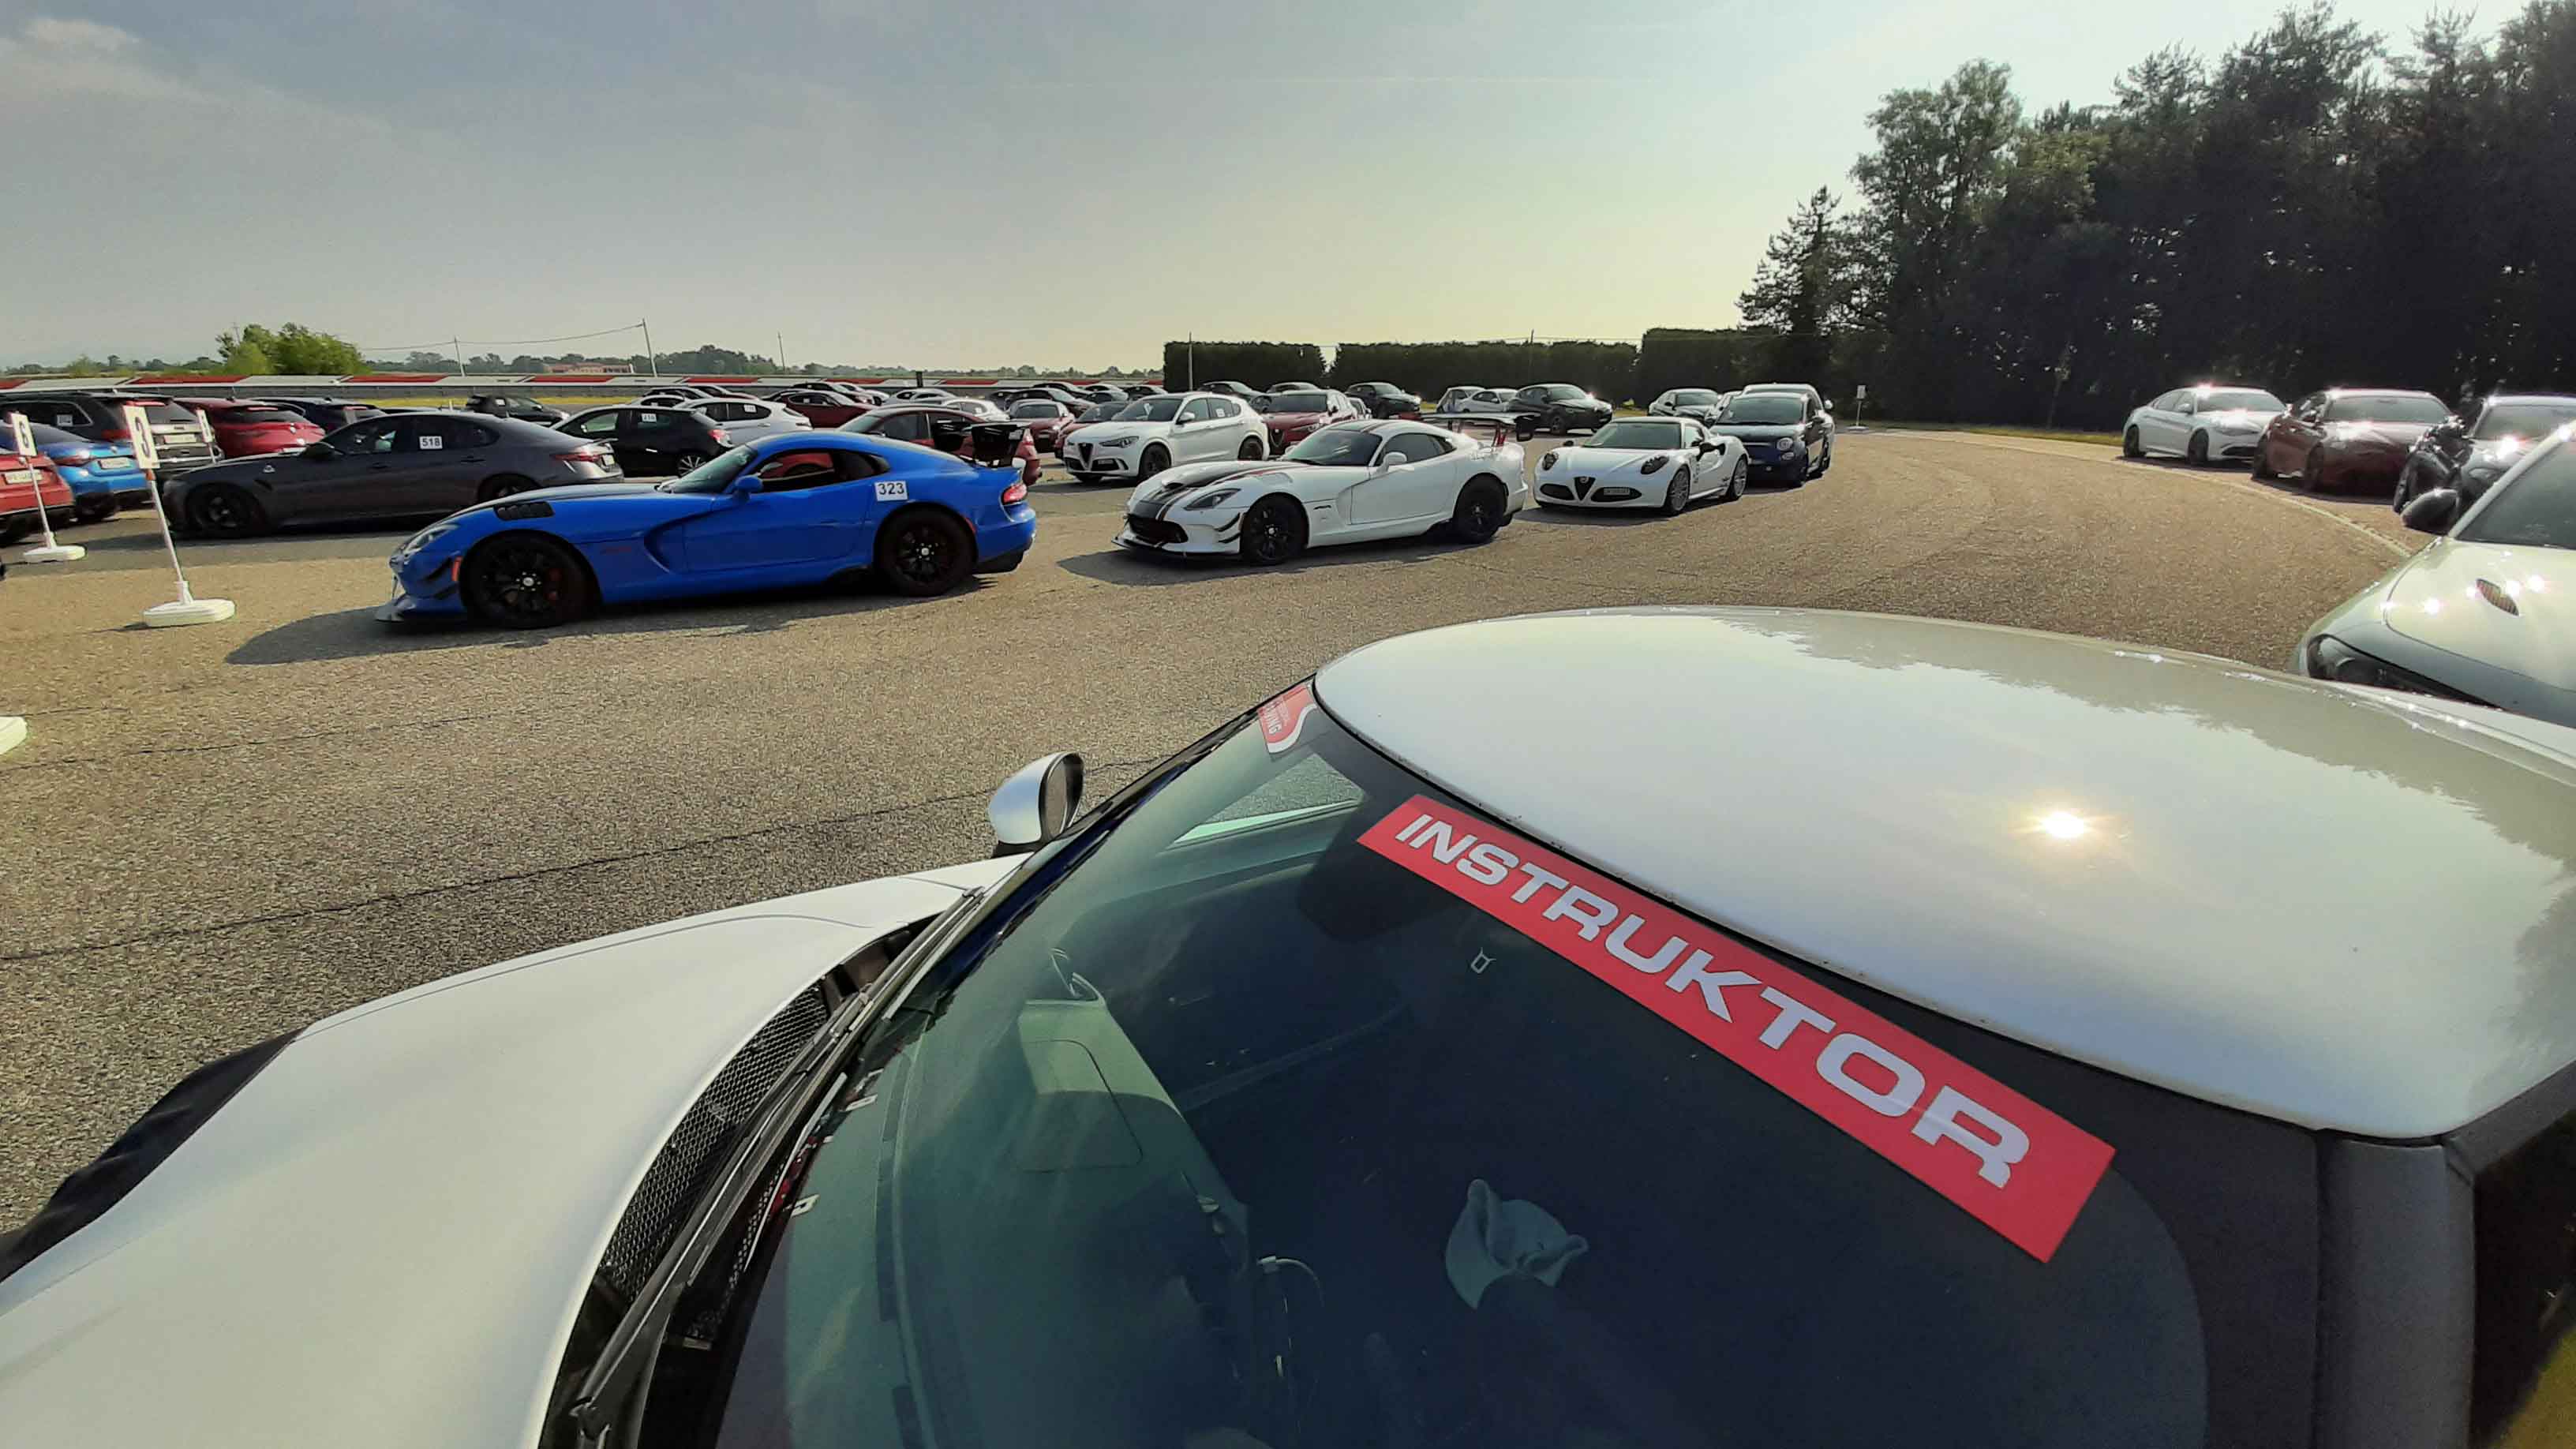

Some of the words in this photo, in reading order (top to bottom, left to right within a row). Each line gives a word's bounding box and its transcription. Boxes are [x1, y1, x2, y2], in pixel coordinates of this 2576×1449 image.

[422, 437, 440, 447] 518
[878, 482, 904, 495] 323
[1394, 814, 2030, 1189] INSTRUKTOR
